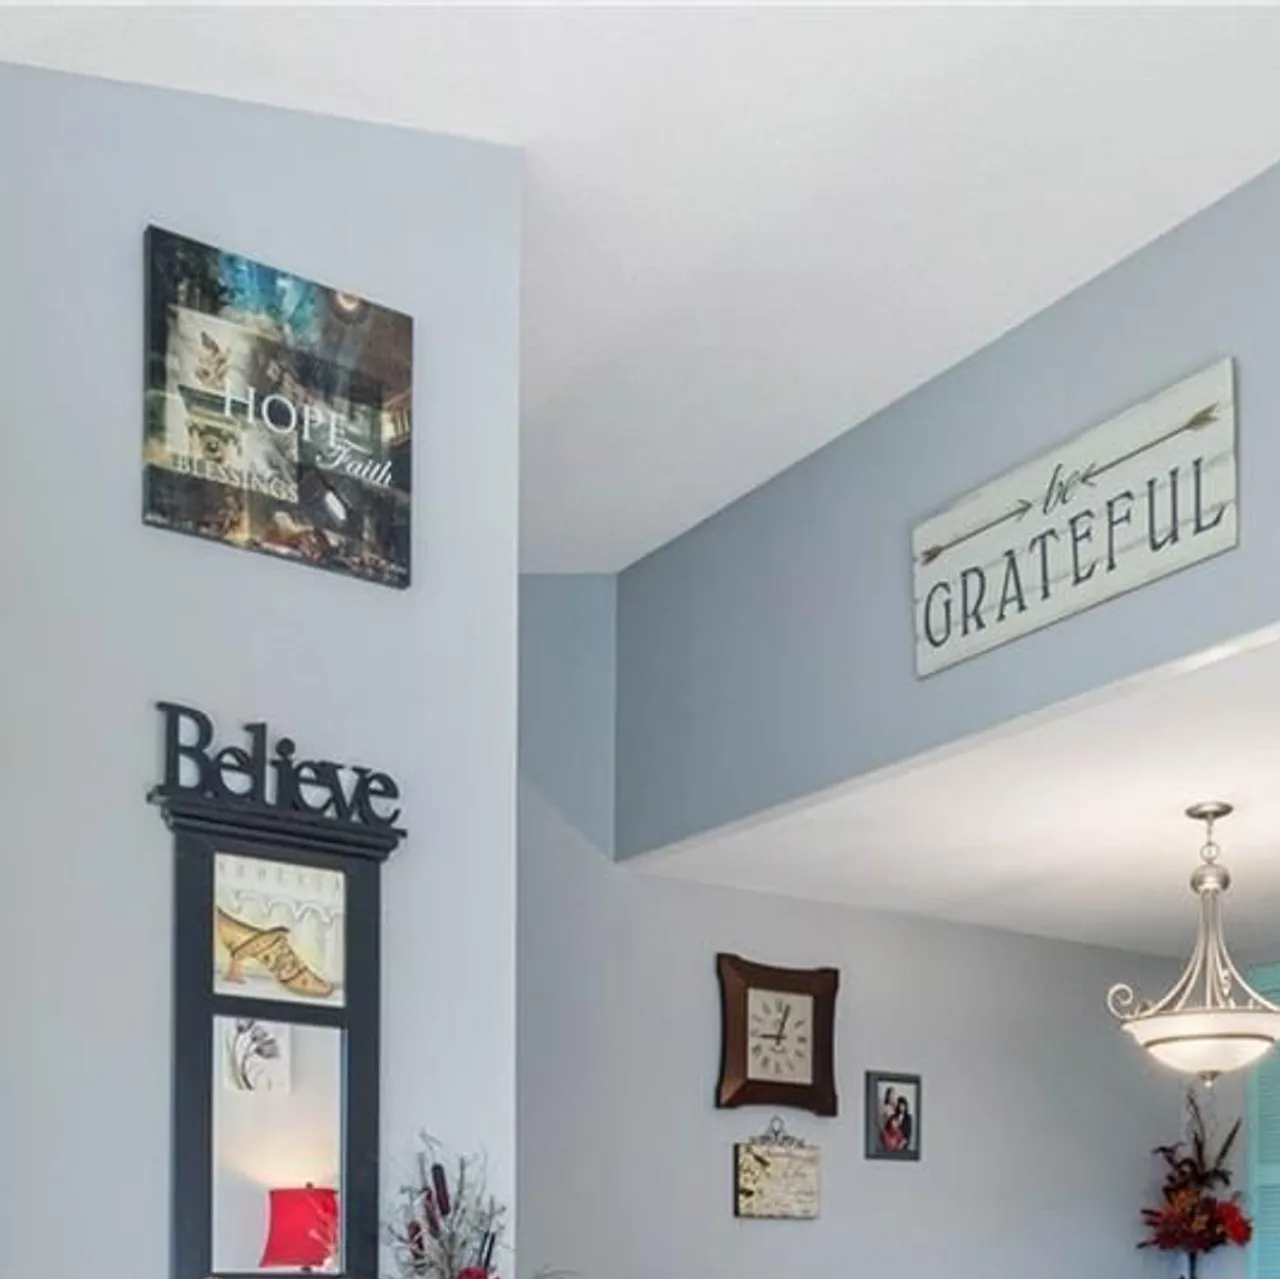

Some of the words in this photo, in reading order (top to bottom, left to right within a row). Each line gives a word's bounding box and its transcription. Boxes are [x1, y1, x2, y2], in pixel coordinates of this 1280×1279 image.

[223, 383, 348, 448] HOPE
[172, 455, 299, 504] BLESSINGS
[316, 438, 393, 489] Faith
[1042, 463, 1083, 515] be
[924, 457, 1227, 648] GRATEFUL
[155, 701, 401, 829] Believe
